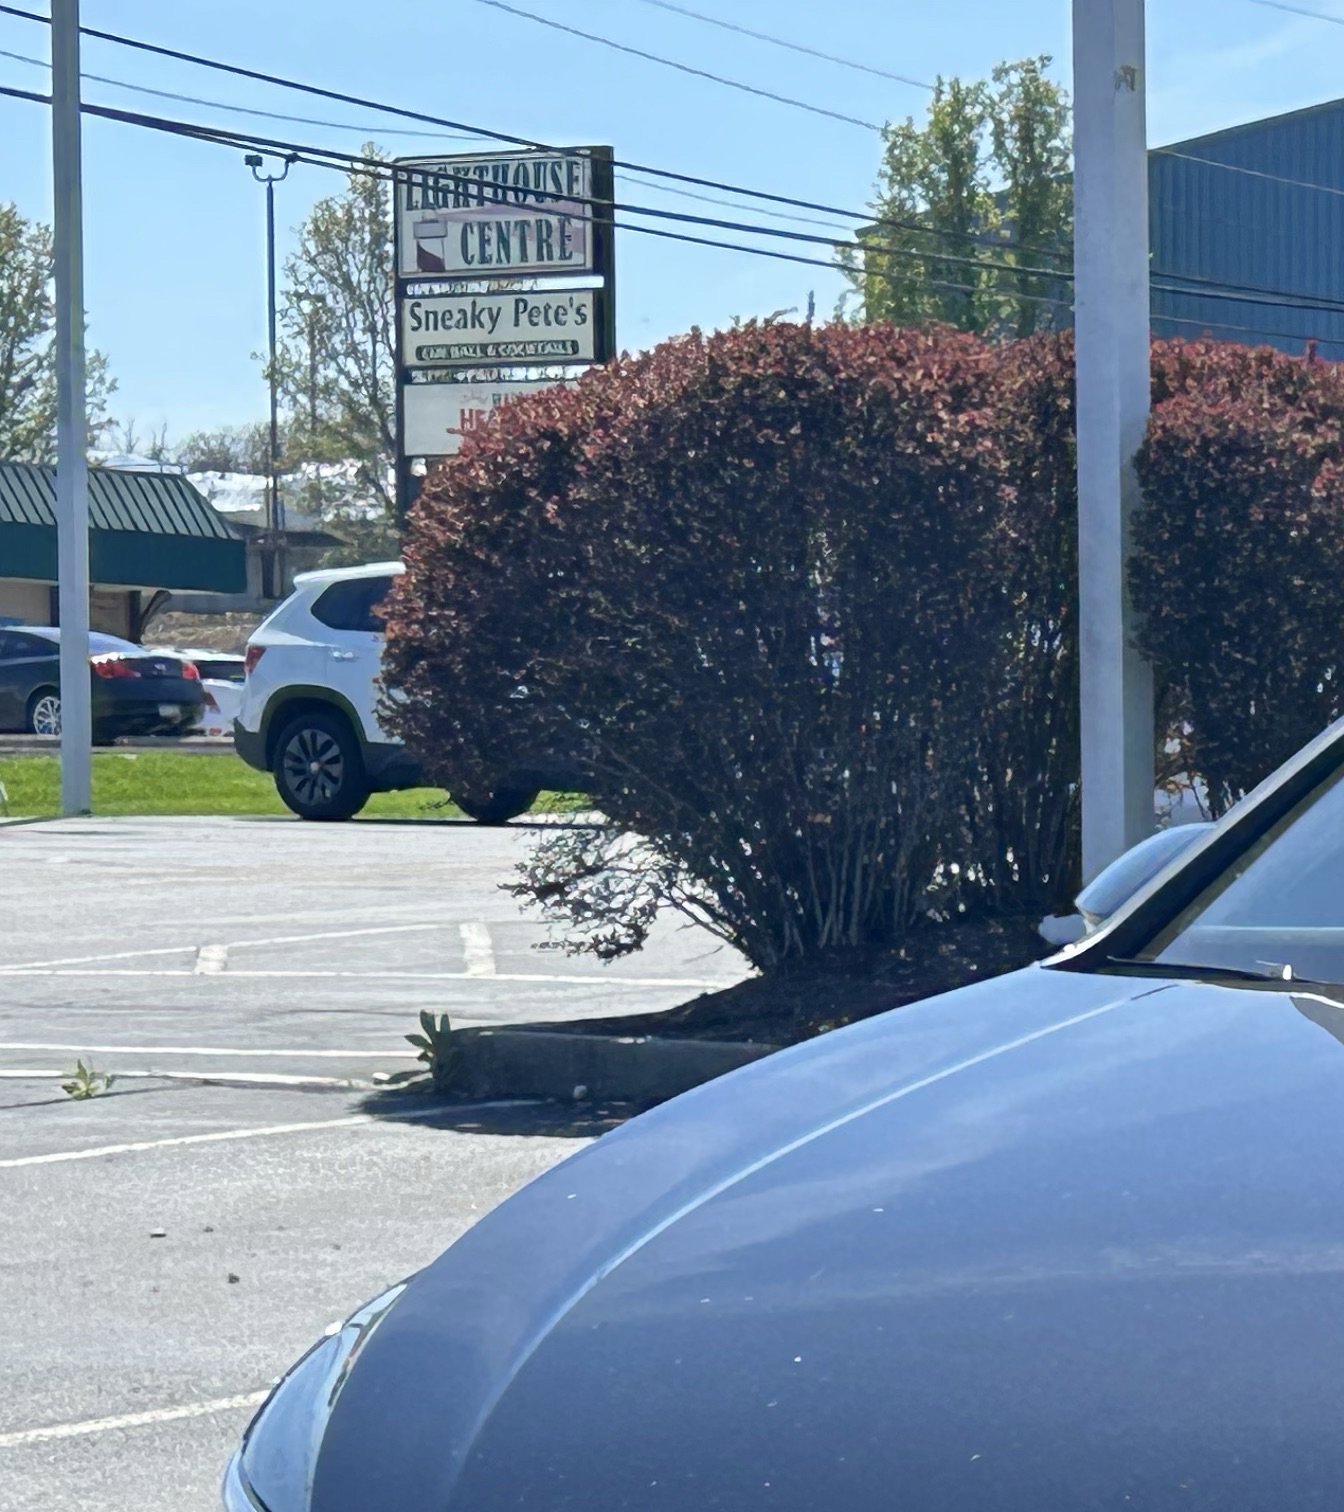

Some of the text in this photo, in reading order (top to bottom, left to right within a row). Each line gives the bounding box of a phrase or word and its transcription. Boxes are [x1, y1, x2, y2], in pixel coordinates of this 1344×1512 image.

[406, 161, 581, 211] LIGHTHOUSE
[460, 217, 573, 266] CENTRE
[410, 296, 588, 335] Sneaky Pete's
